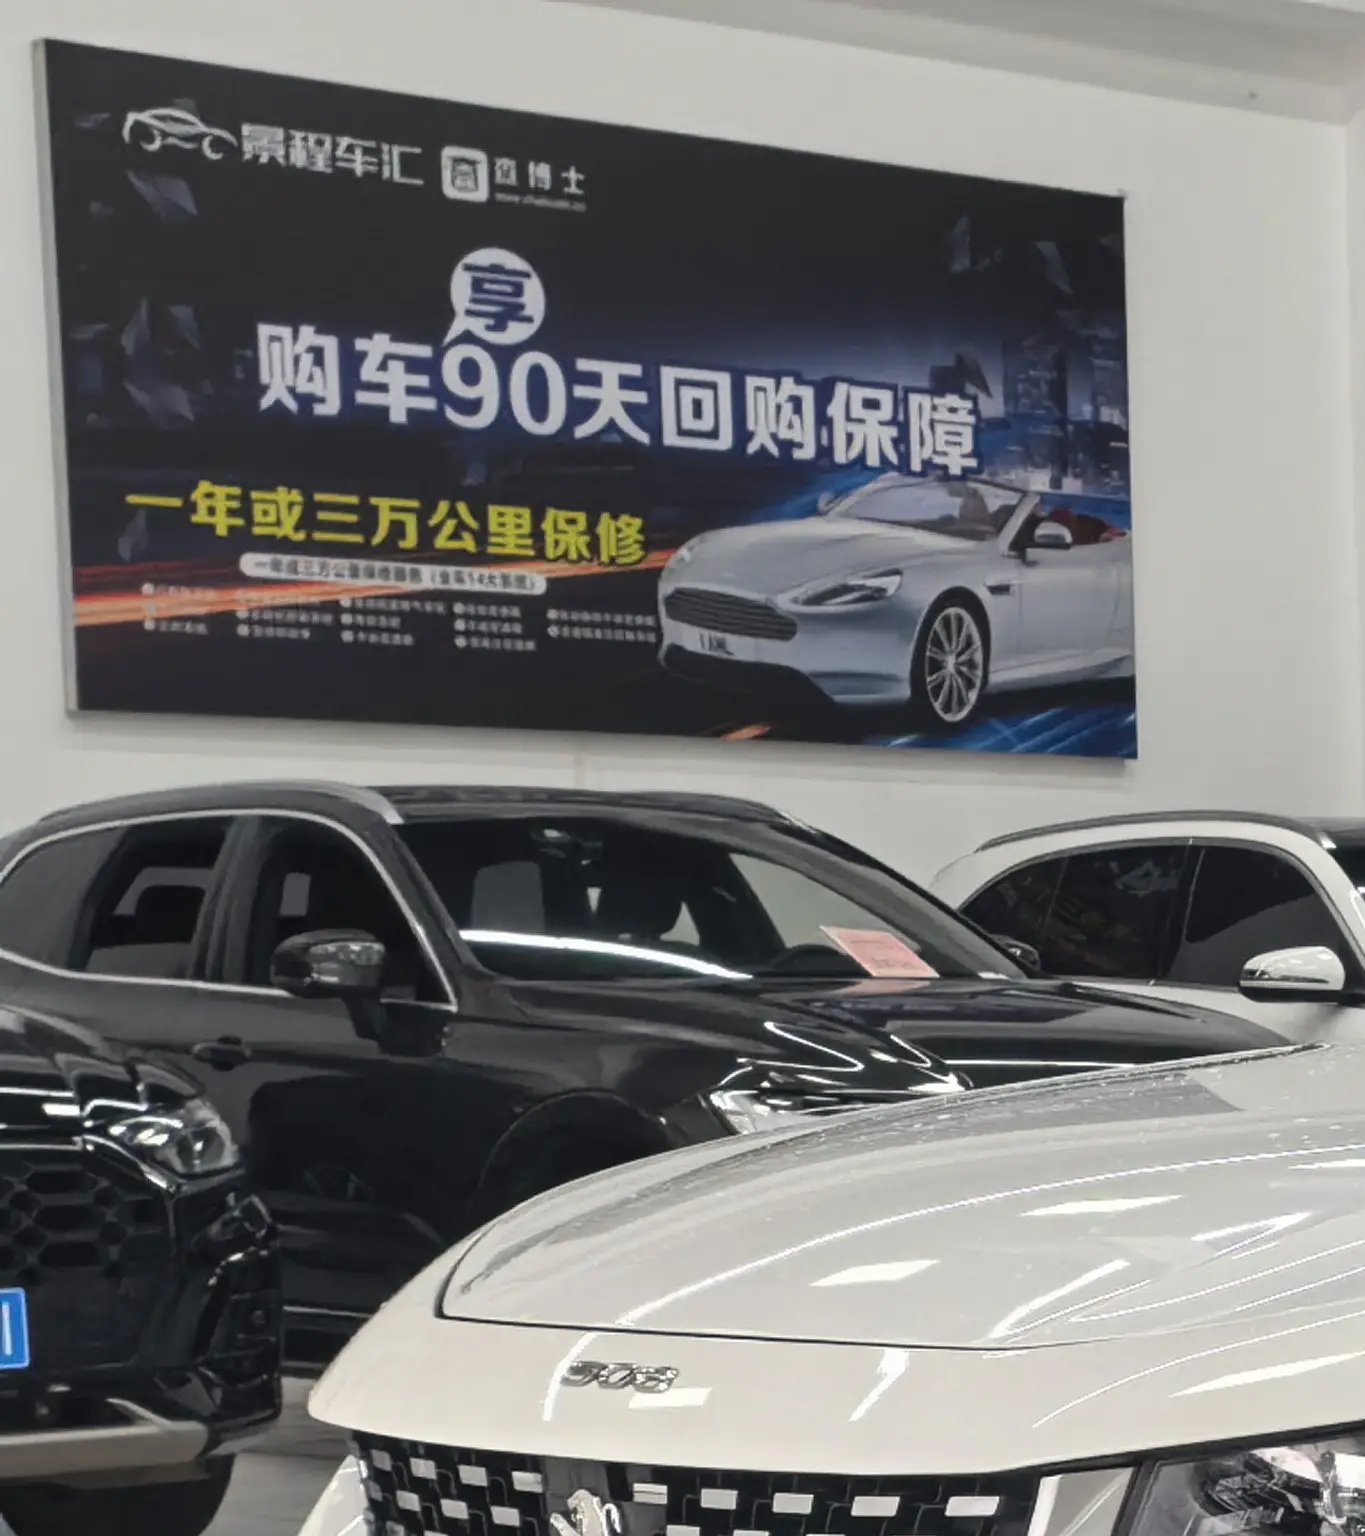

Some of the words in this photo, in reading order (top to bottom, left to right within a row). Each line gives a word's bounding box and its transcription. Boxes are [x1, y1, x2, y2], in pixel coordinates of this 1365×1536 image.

[240, 121, 425, 186] 景程车汇
[462, 262, 535, 333] 享
[256, 321, 979, 477] 购车90天回购保障
[125, 479, 646, 565] 一年或三万公里保修
